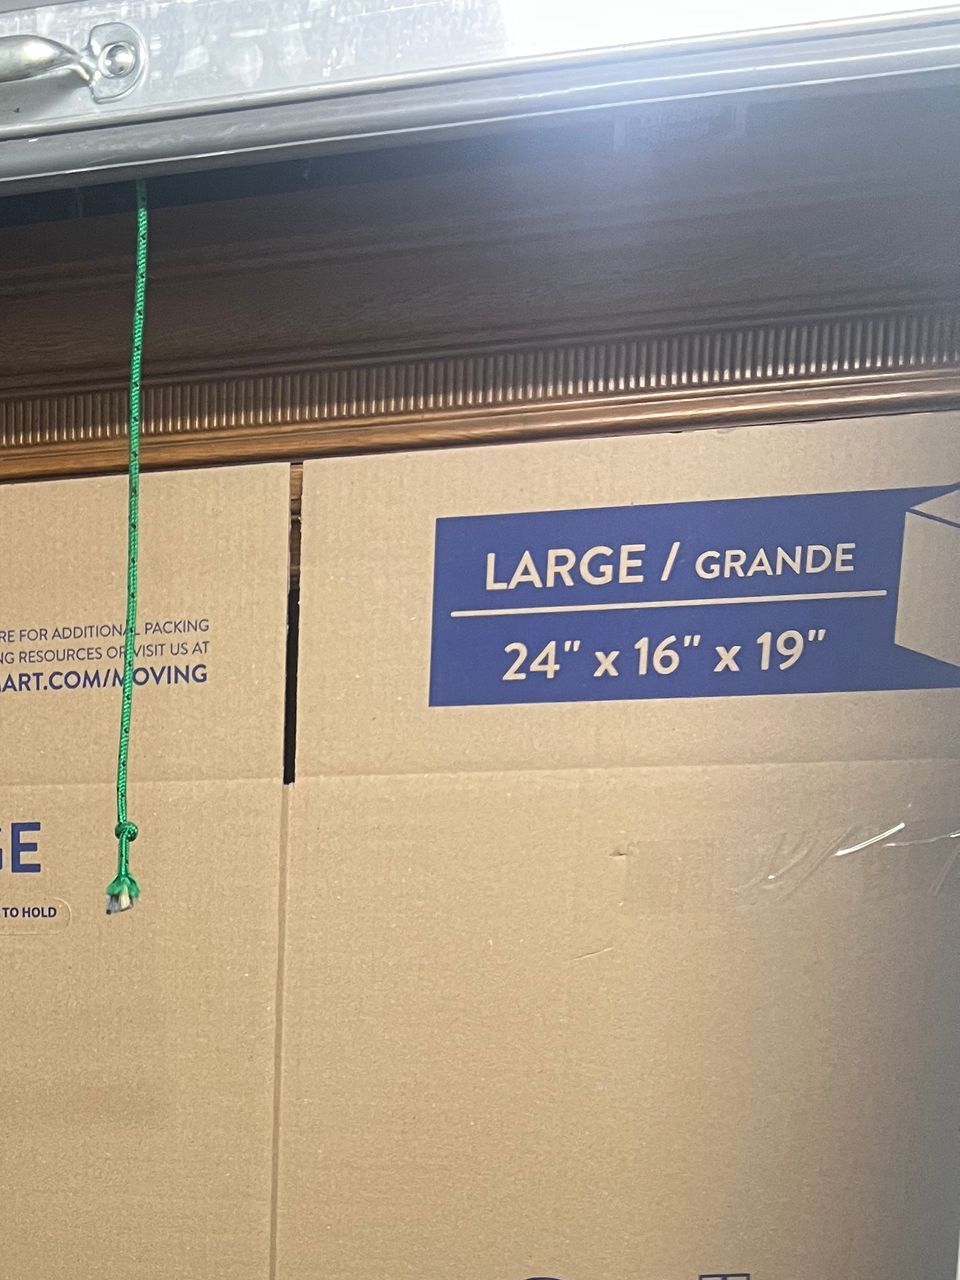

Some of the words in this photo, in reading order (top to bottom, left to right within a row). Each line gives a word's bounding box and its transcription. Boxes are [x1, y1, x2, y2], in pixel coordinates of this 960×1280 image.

[485, 543, 646, 590] LARGE
[660, 541, 681, 581] /
[695, 542, 856, 580] GRANDE
[19, 628, 48, 642] FOR
[144, 619, 210, 635] PACKING
[19, 647, 103, 664] RESOURCES
[133, 643, 166, 658] VISIT
[170, 642, 189, 656] US
[192, 641, 211, 655] AT
[502, 640, 581, 680] 24"
[593, 650, 620, 677] x
[634, 634, 701, 675] 16"
[713, 645, 741, 672] x
[756, 629, 826, 671] 19"
[2, 907, 19, 918] TO
[22, 907, 57, 918] HOLD
